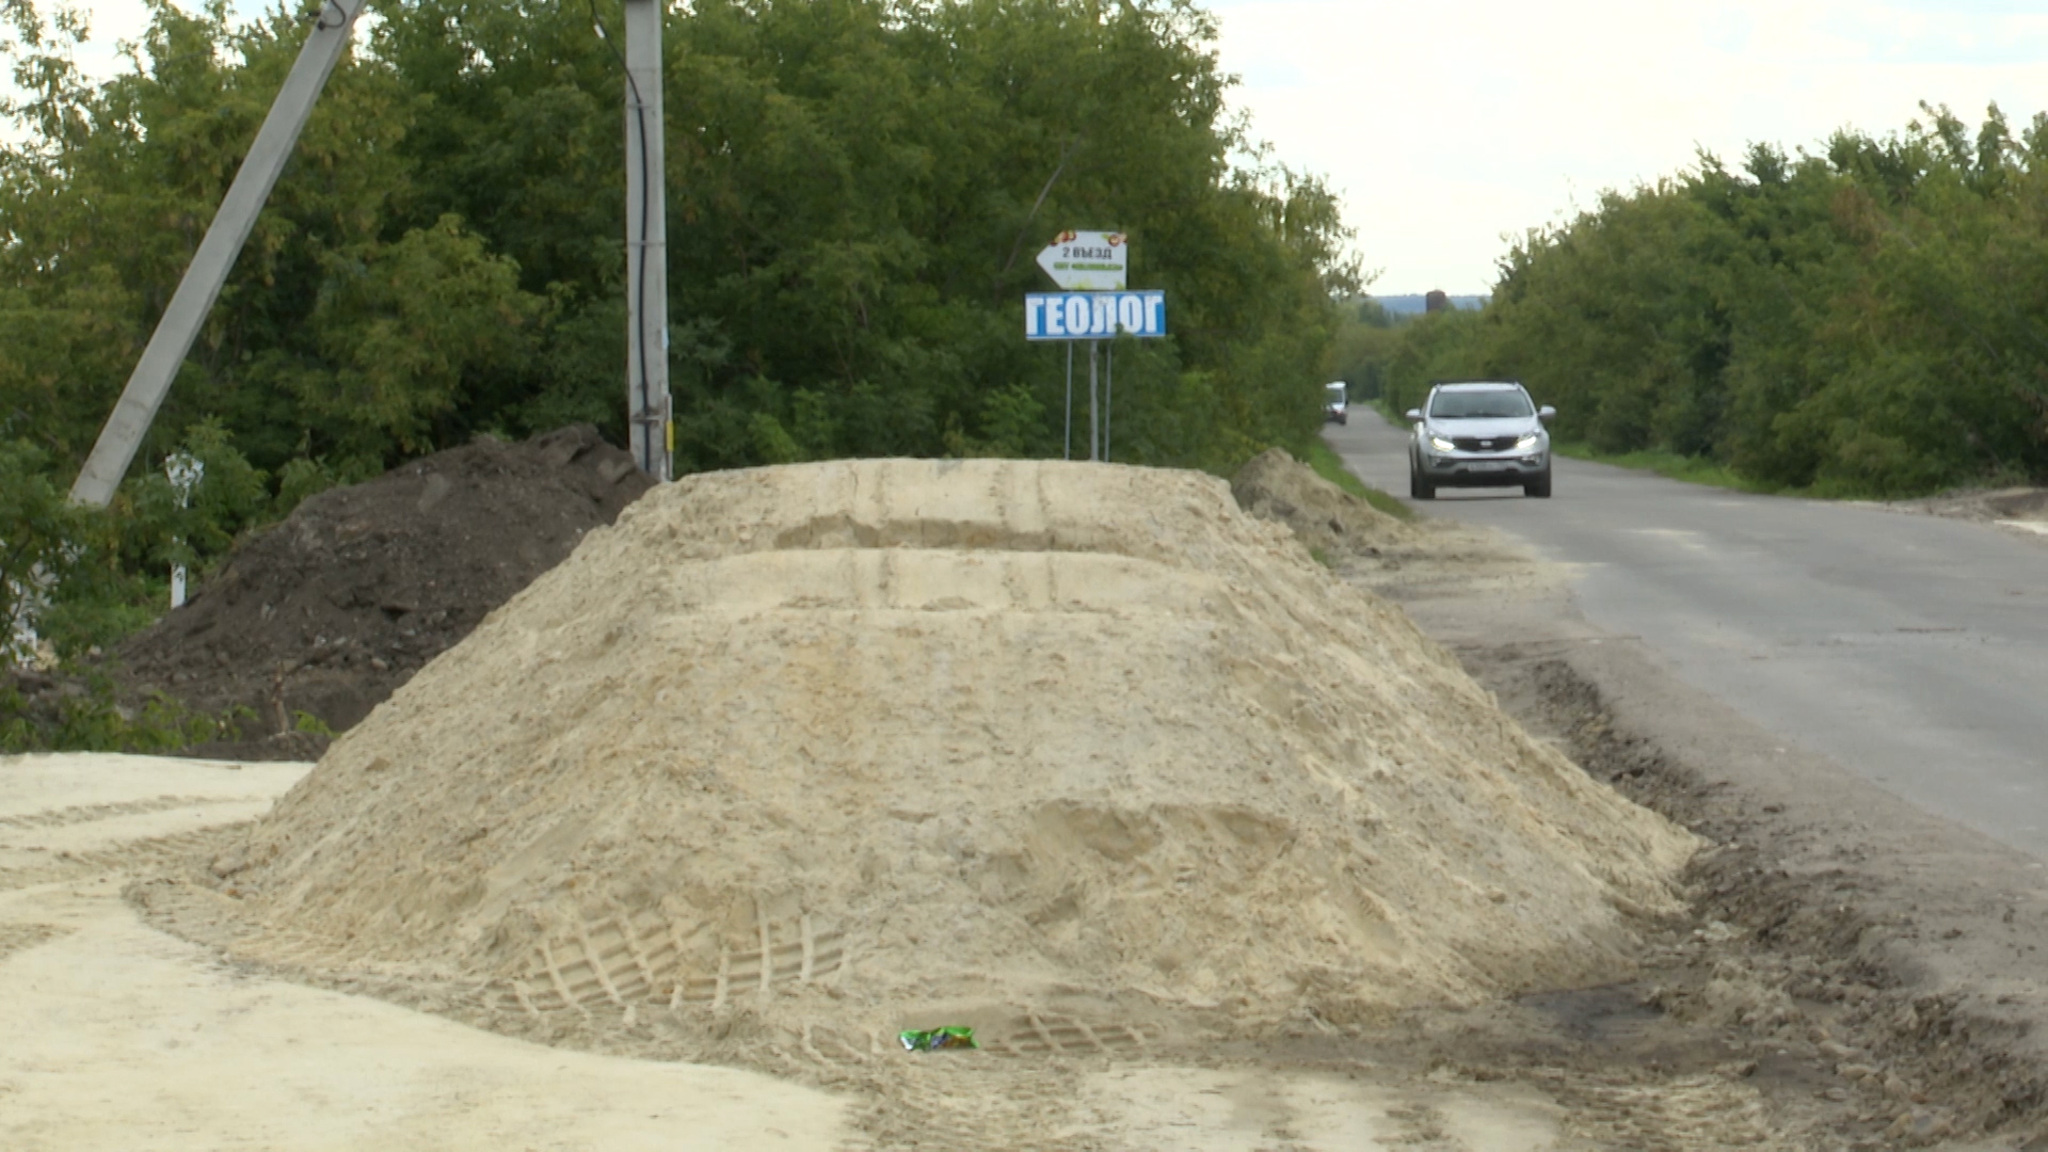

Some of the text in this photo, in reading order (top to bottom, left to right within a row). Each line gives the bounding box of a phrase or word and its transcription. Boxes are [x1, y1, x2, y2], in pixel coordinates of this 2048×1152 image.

[1062, 247, 1112, 260] 2 ВЪЕЗД
[1025, 295, 1163, 335] ГЕОЛОГ
